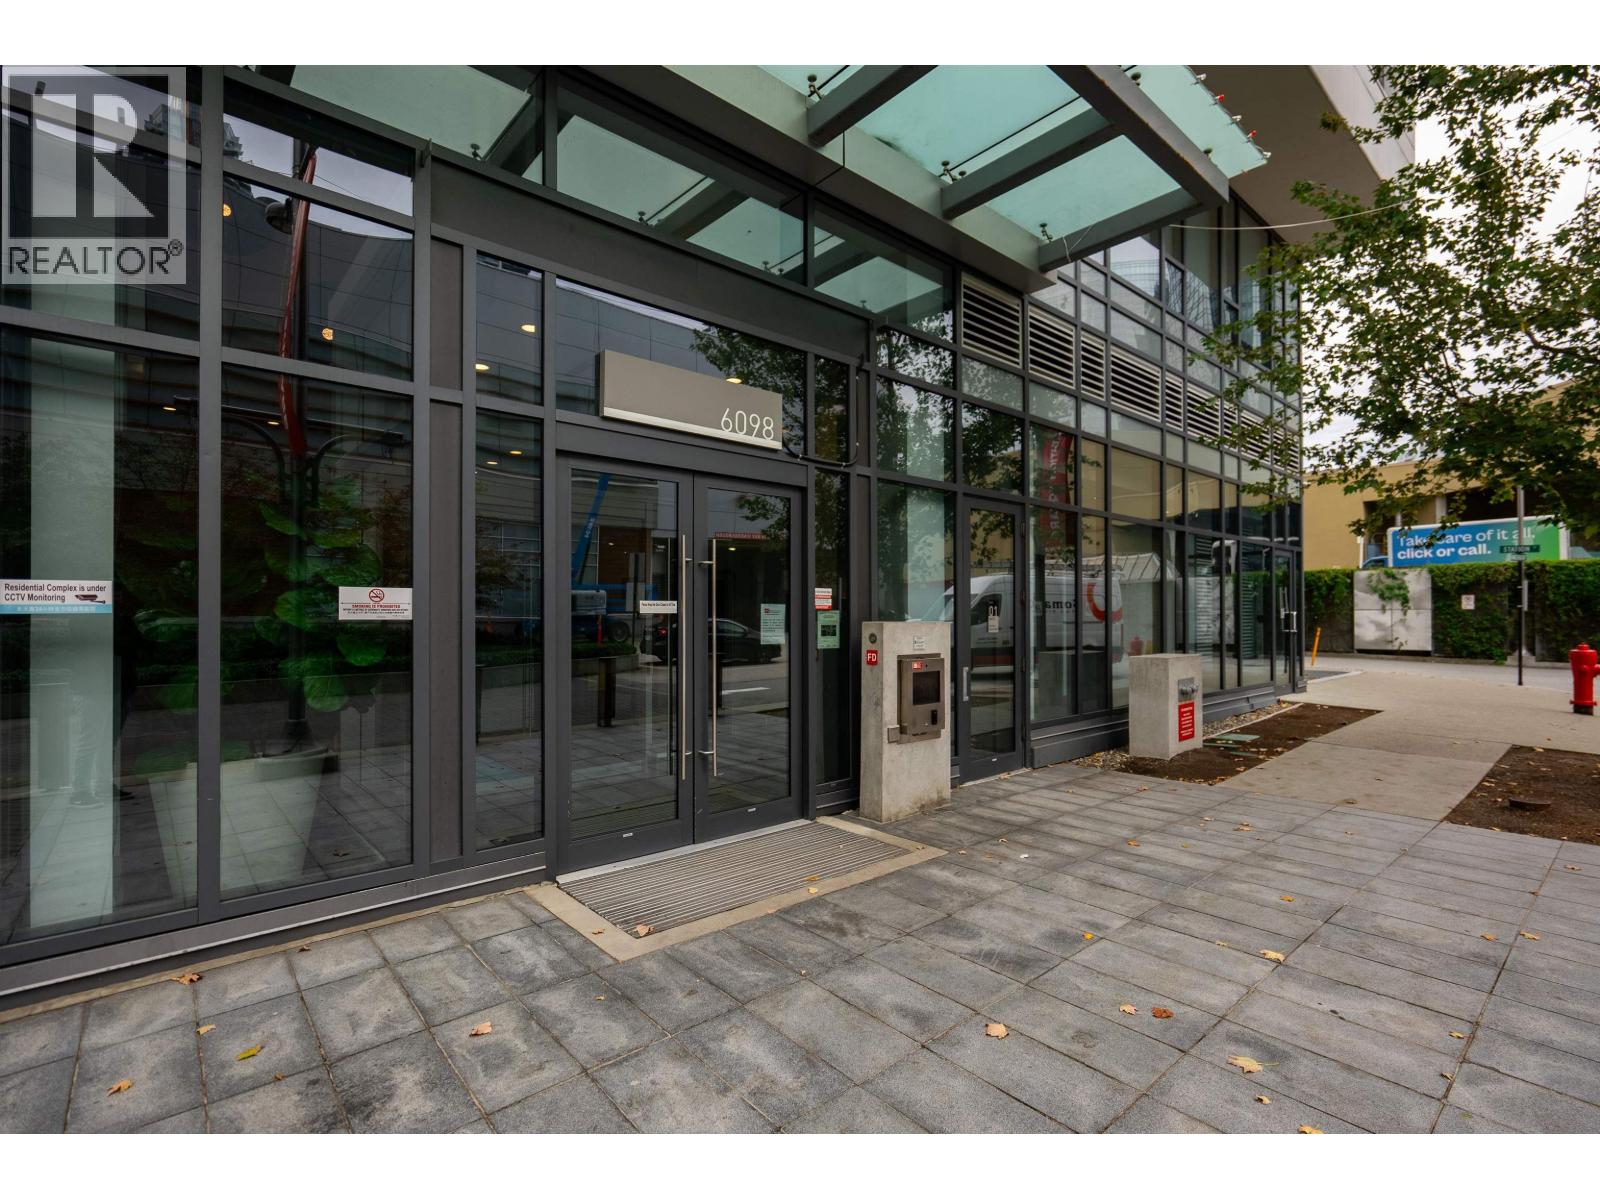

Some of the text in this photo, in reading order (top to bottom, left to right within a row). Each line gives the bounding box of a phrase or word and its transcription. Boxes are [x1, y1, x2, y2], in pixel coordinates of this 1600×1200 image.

[721, 407, 774, 440] 6098
[1475, 529, 1495, 542] of
[1497, 528, 1509, 540] it
[1397, 543, 1491, 560] click or call.
[4, 583, 107, 593] Residential Complex is under
[4, 593, 66, 603] CCTV Monitoring
[867, 652, 877, 662] FD
